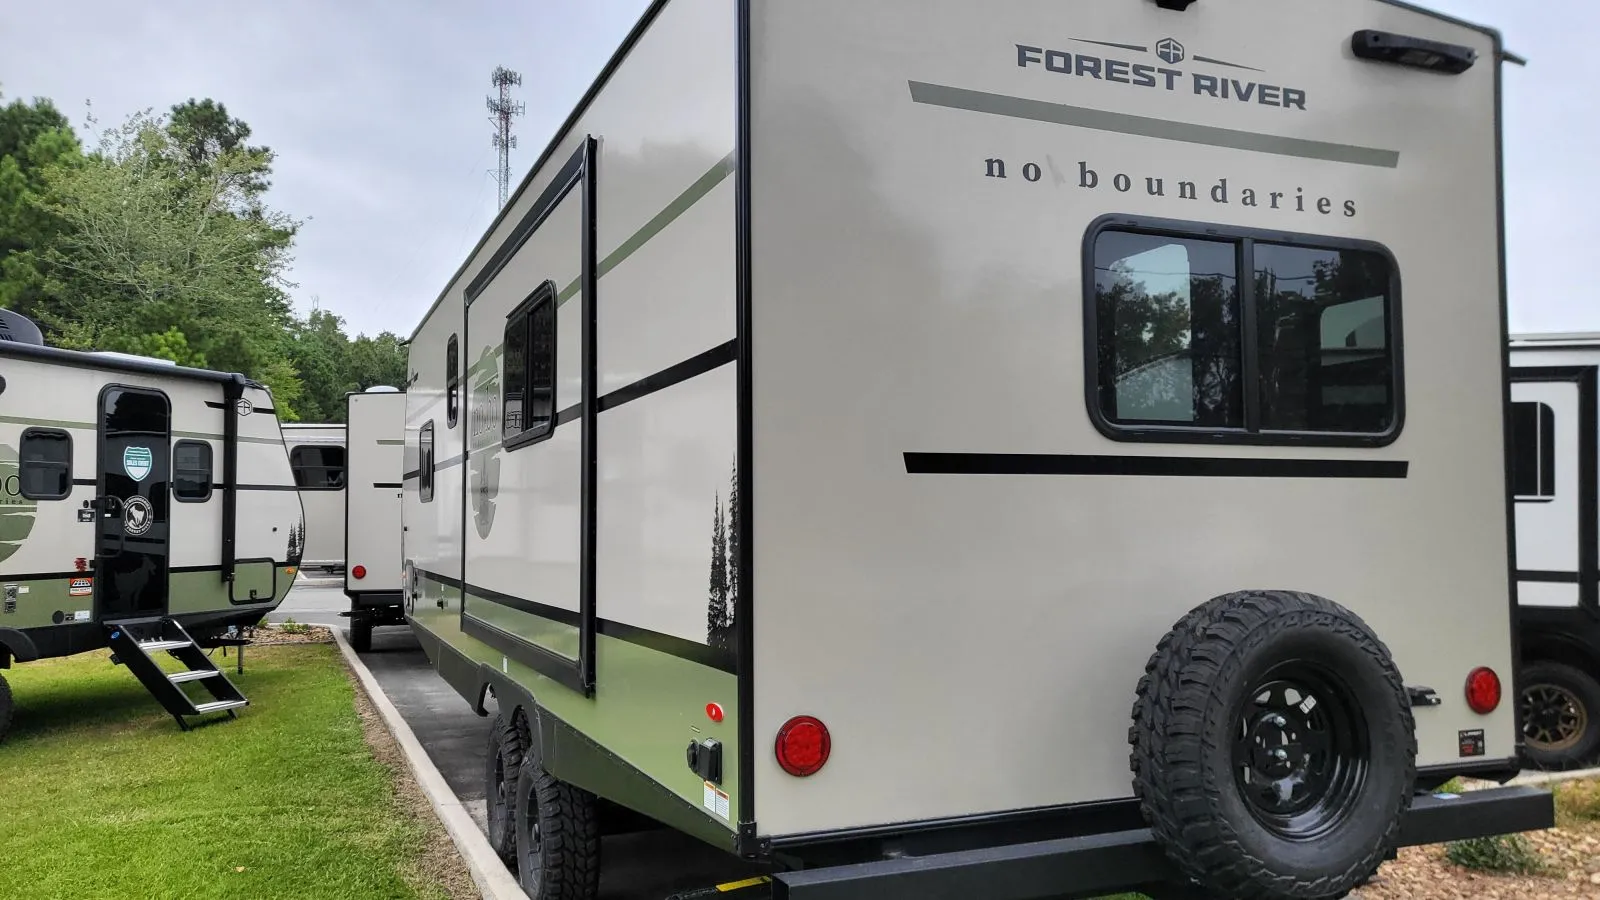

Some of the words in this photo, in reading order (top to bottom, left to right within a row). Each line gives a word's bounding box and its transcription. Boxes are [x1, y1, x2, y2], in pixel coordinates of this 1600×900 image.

[1015, 44, 1182, 90] FOREST
[1192, 72, 1307, 110] RIVER
[984, 158, 1042, 182] no
[1078, 161, 1357, 218] boundaries
